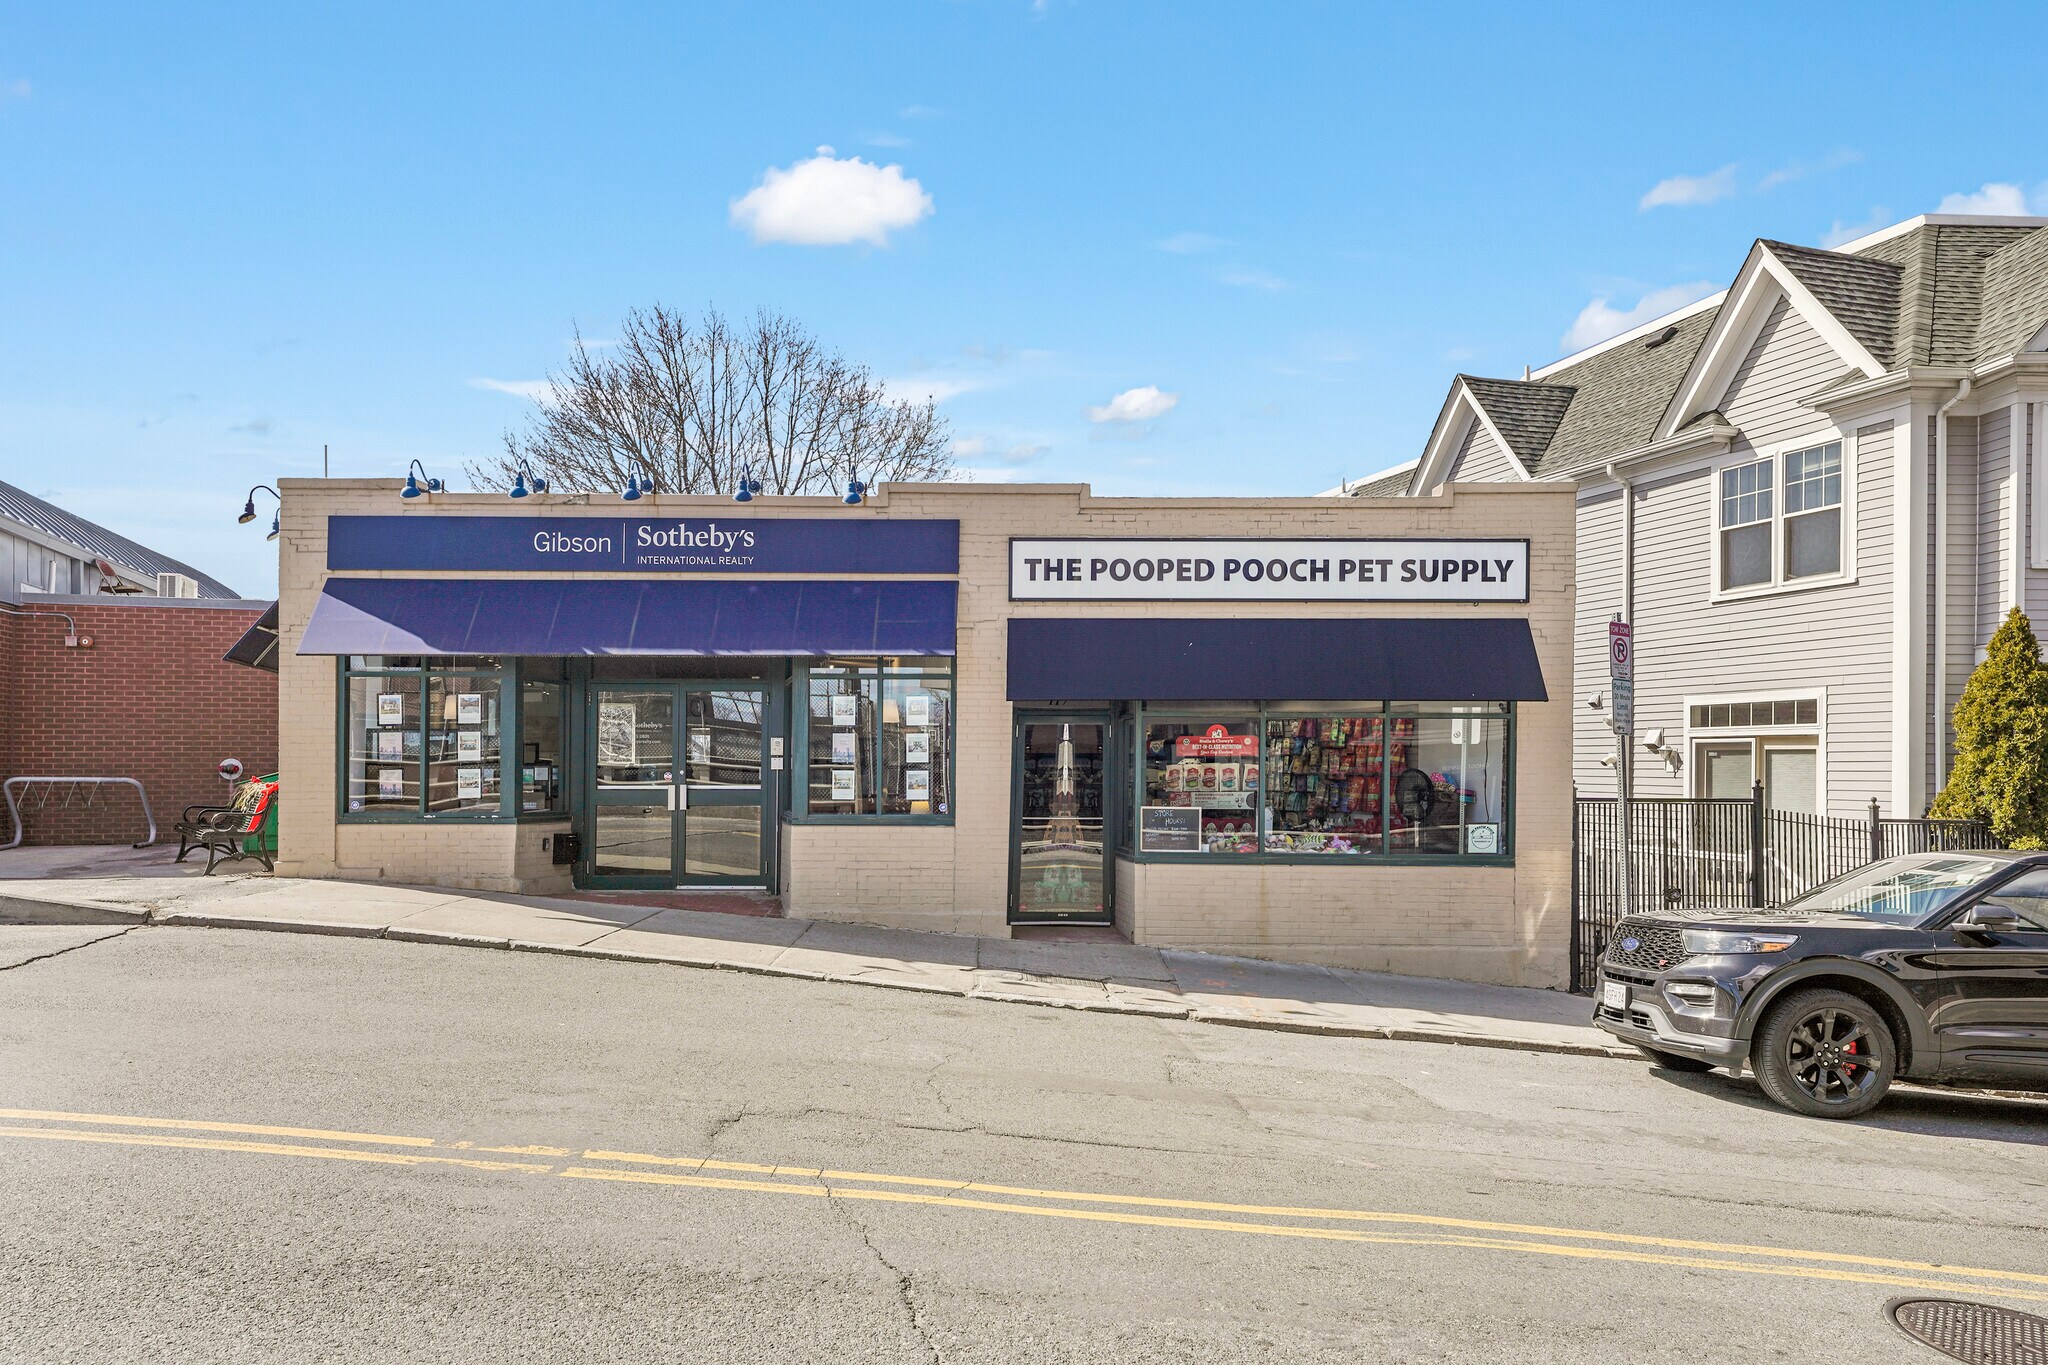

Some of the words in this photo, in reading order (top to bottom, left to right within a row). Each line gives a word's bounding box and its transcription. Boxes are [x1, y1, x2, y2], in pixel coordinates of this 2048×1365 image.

[533, 531, 611, 553] Gibson
[637, 523, 755, 553] Sotheby's
[637, 556, 717, 565] INTERNATIONAL
[718, 556, 755, 565] REALTY
[1024, 558, 1082, 582] THE
[1090, 558, 1215, 582] POOPED
[1223, 558, 1330, 582] POOCH
[1338, 558, 1394, 582] PET
[1400, 558, 1514, 583] SUPPLY
[1614, 682, 1631, 693] Parking
[1617, 703, 1629, 711] Limit
[1154, 810, 1174, 818] STORE
